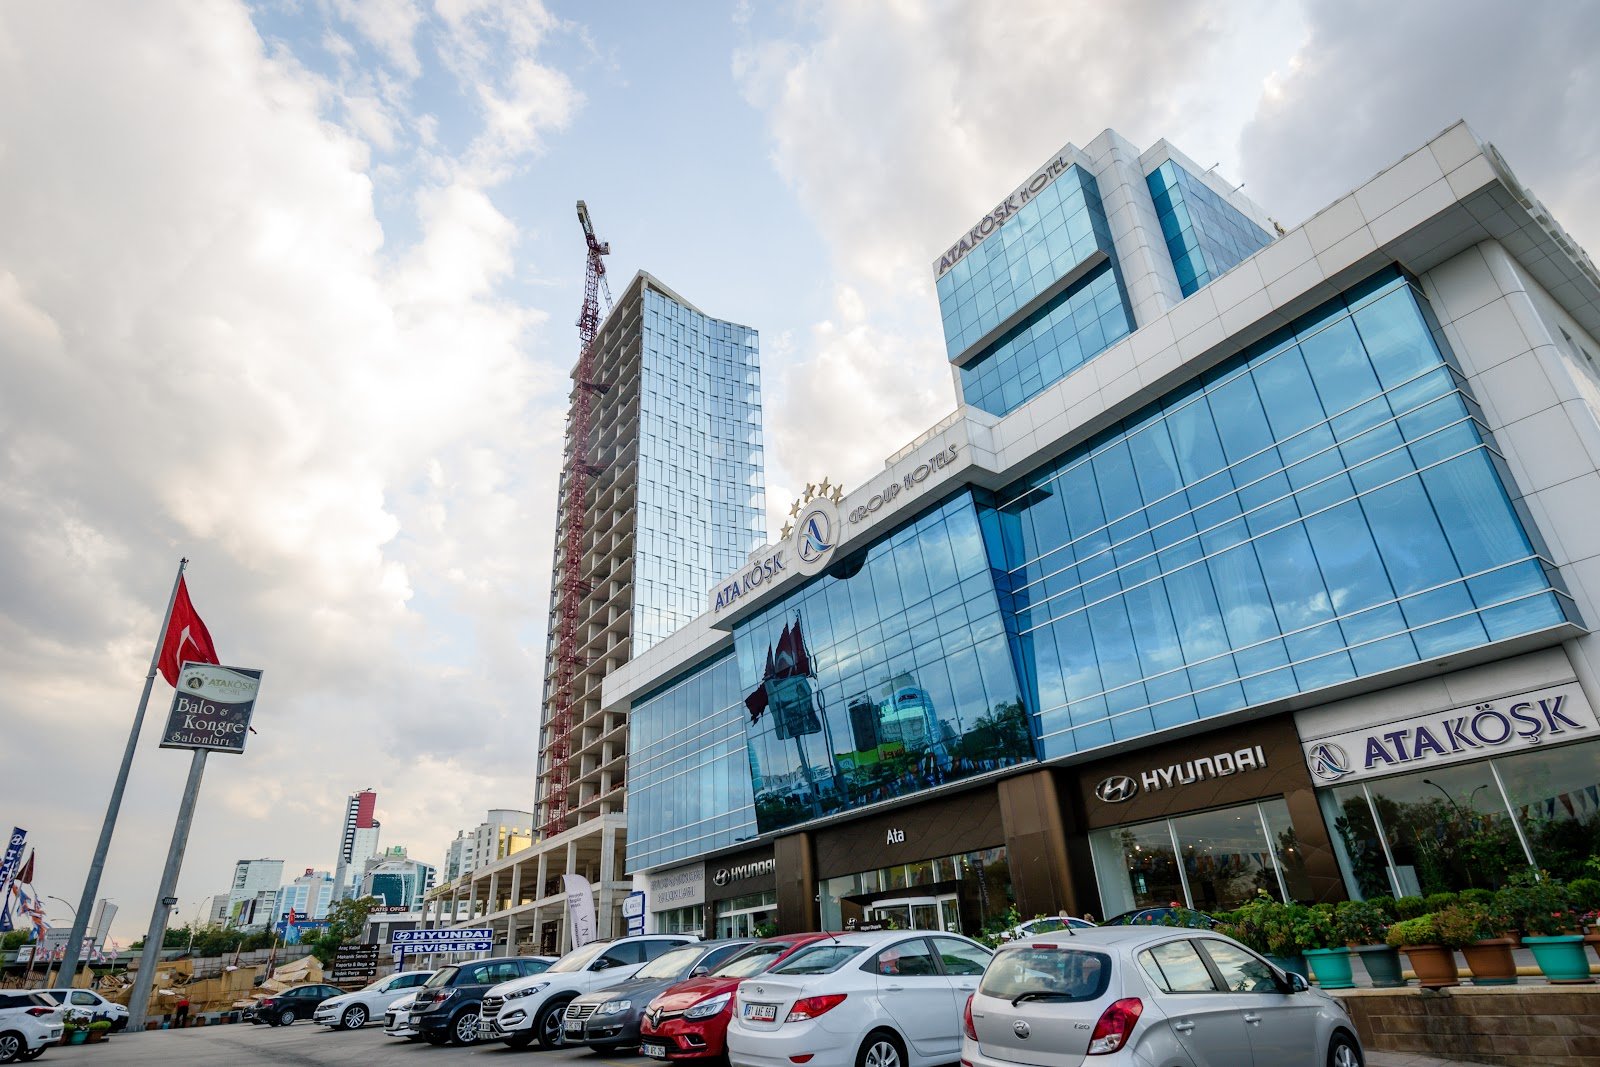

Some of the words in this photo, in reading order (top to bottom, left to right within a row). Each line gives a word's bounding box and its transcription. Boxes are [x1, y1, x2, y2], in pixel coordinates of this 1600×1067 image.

[939, 195, 1019, 275] ATAKÖŞK
[1020, 156, 1069, 203] HOTEL
[849, 485, 901, 525] GROUP
[904, 444, 958, 490] HOTELS
[714, 550, 786, 613] ATAKÖŞK
[177, 699, 214, 714] Balo
[183, 715, 244, 736] Kongre
[1364, 694, 1586, 771] ATAKÖŞK
[171, 732, 230, 746] Salonları
[1141, 746, 1268, 793] HYUNDAI
[886, 828, 905, 845] Ata
[731, 858, 776, 881] HYUNDAI
[413, 930, 489, 941] HYUNDAI
